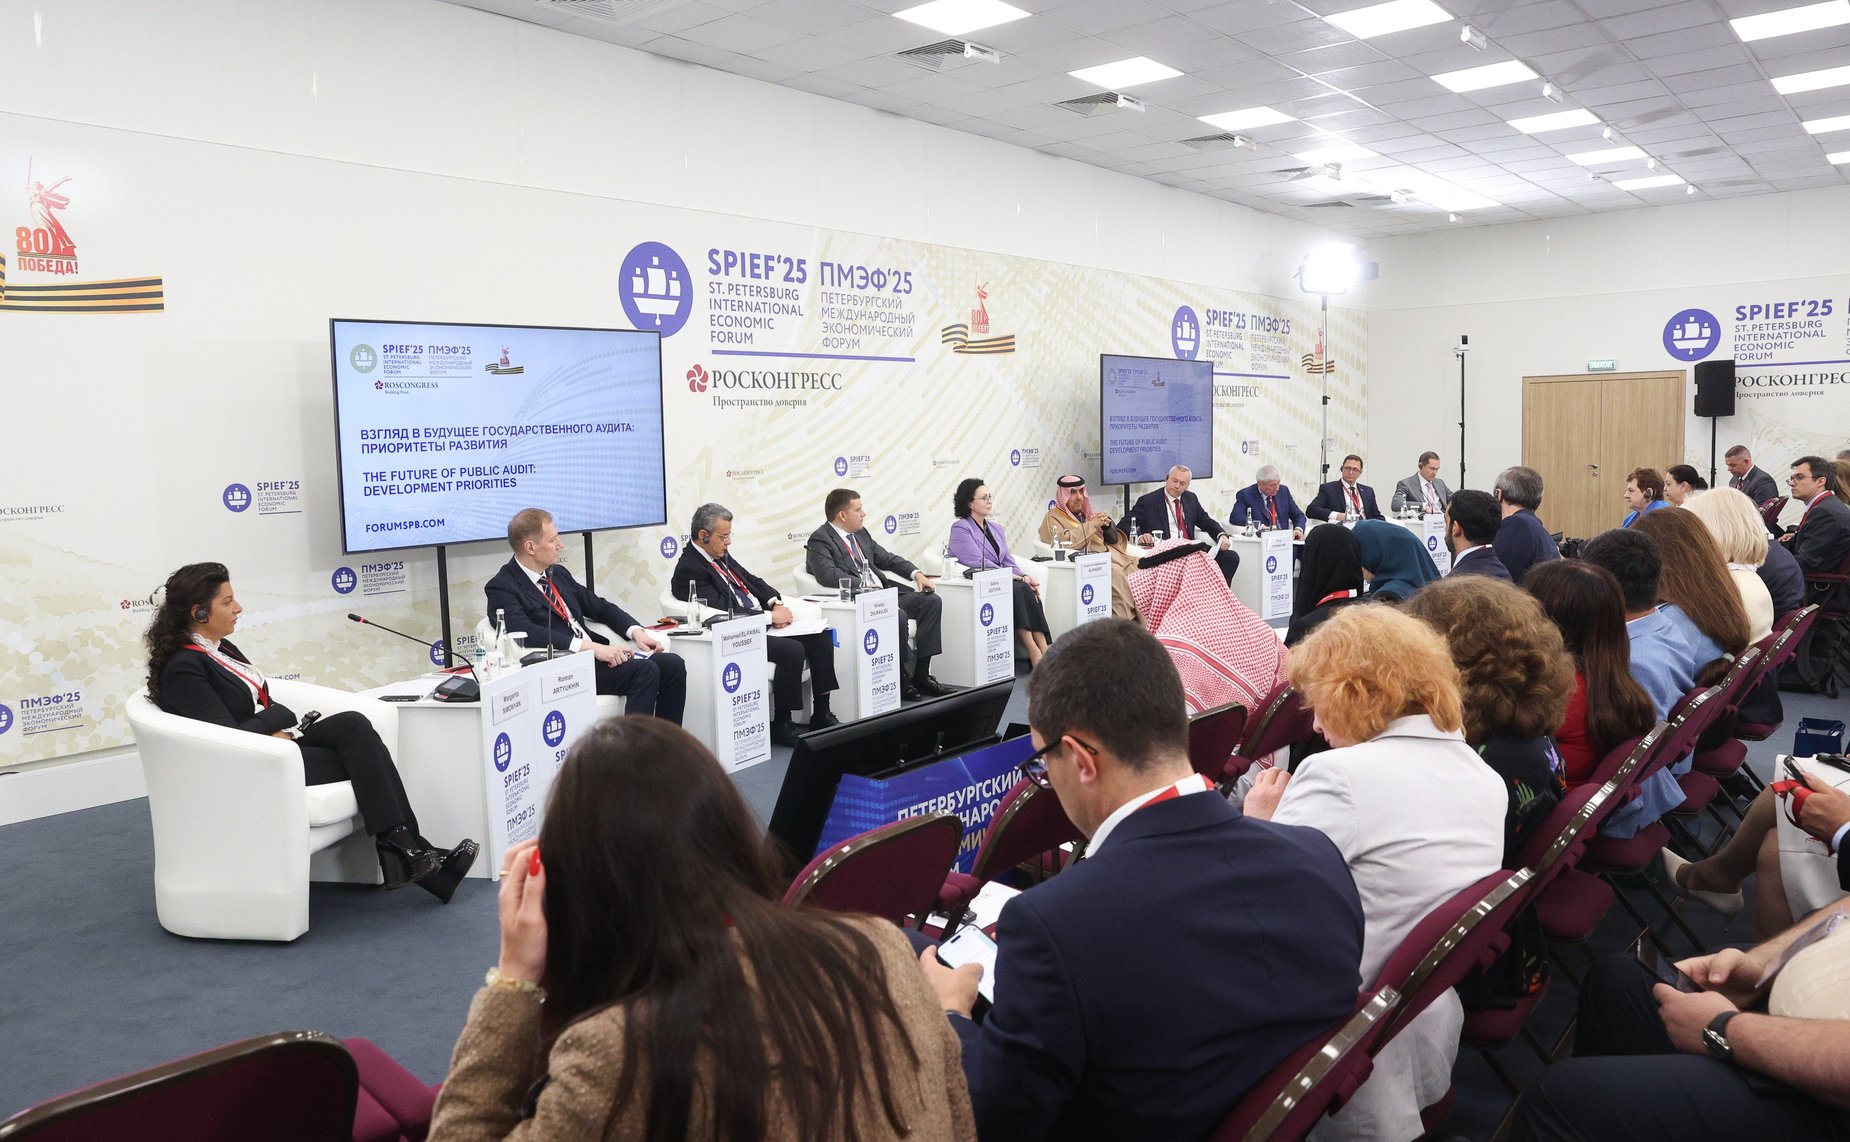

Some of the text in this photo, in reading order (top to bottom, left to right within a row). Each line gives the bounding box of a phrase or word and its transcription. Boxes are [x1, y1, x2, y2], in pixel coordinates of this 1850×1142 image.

[16, 226, 50, 254] 80
[18, 257, 79, 276] ПОБЕДА!
[709, 281, 799, 301] ST. PETERSBURG
[709, 297, 804, 317] INTERNATIONAL
[821, 291, 903, 310] ПЕТЕРБУРГСКИЙ
[710, 314, 775, 330] ECONOMIC
[821, 307, 915, 325] МЕЖДУНАРОДНЫЙ
[822, 321, 914, 339] ЭКОНОМИЧЕСКИЙ
[1735, 320, 1822, 333] ST. PETERSBURG
[710, 330, 754, 345] FORUM
[1213, 330, 1243, 341] PETERSBURG
[1734, 329, 1827, 342] INTERNATIONAL
[822, 337, 860, 350] ФОРУМ
[1206, 340, 1244, 351] INTERNATIONAL
[1734, 341, 1795, 352] ECONOMIC
[1206, 350, 1232, 360] ECONOMIC
[1734, 352, 1773, 361] FORUM
[384, 381, 439, 389] ROSCONGRESS
[712, 370, 843, 390] РОСКОНГРЕСС
[1791, 390, 1824, 398] доверия
[713, 396, 807, 410] Пространство доверия
[361, 423, 635, 440] ВЗГЛЯД В БУДУЩЕЕ ГОСУДАРСТВЕННОГО АУДИТА:
[361, 439, 508, 454] ПРИОРИТЕТЫ РАЗВИТИЯ
[363, 464, 536, 482] THE FUTURE OF PUBLIC AUDIT:
[363, 478, 517, 497] DEVELOPMENT PRIORITIES
[365, 518, 445, 533] FORUMSPB.COM
[732, 638, 752, 648] YOUSSEF
[558, 674, 574, 683] Roman
[552, 682, 580, 694] ARTYUKHIN
[21, 703, 74, 715] ПЕТЕРБУРГСКИЙ
[21, 707, 83, 721] МЕЖДУНАРОДНЫЙ
[22, 714, 82, 727] ЭКОНОМИЧЕСКИЙ
[23, 724, 48, 732] ФОРУМ
